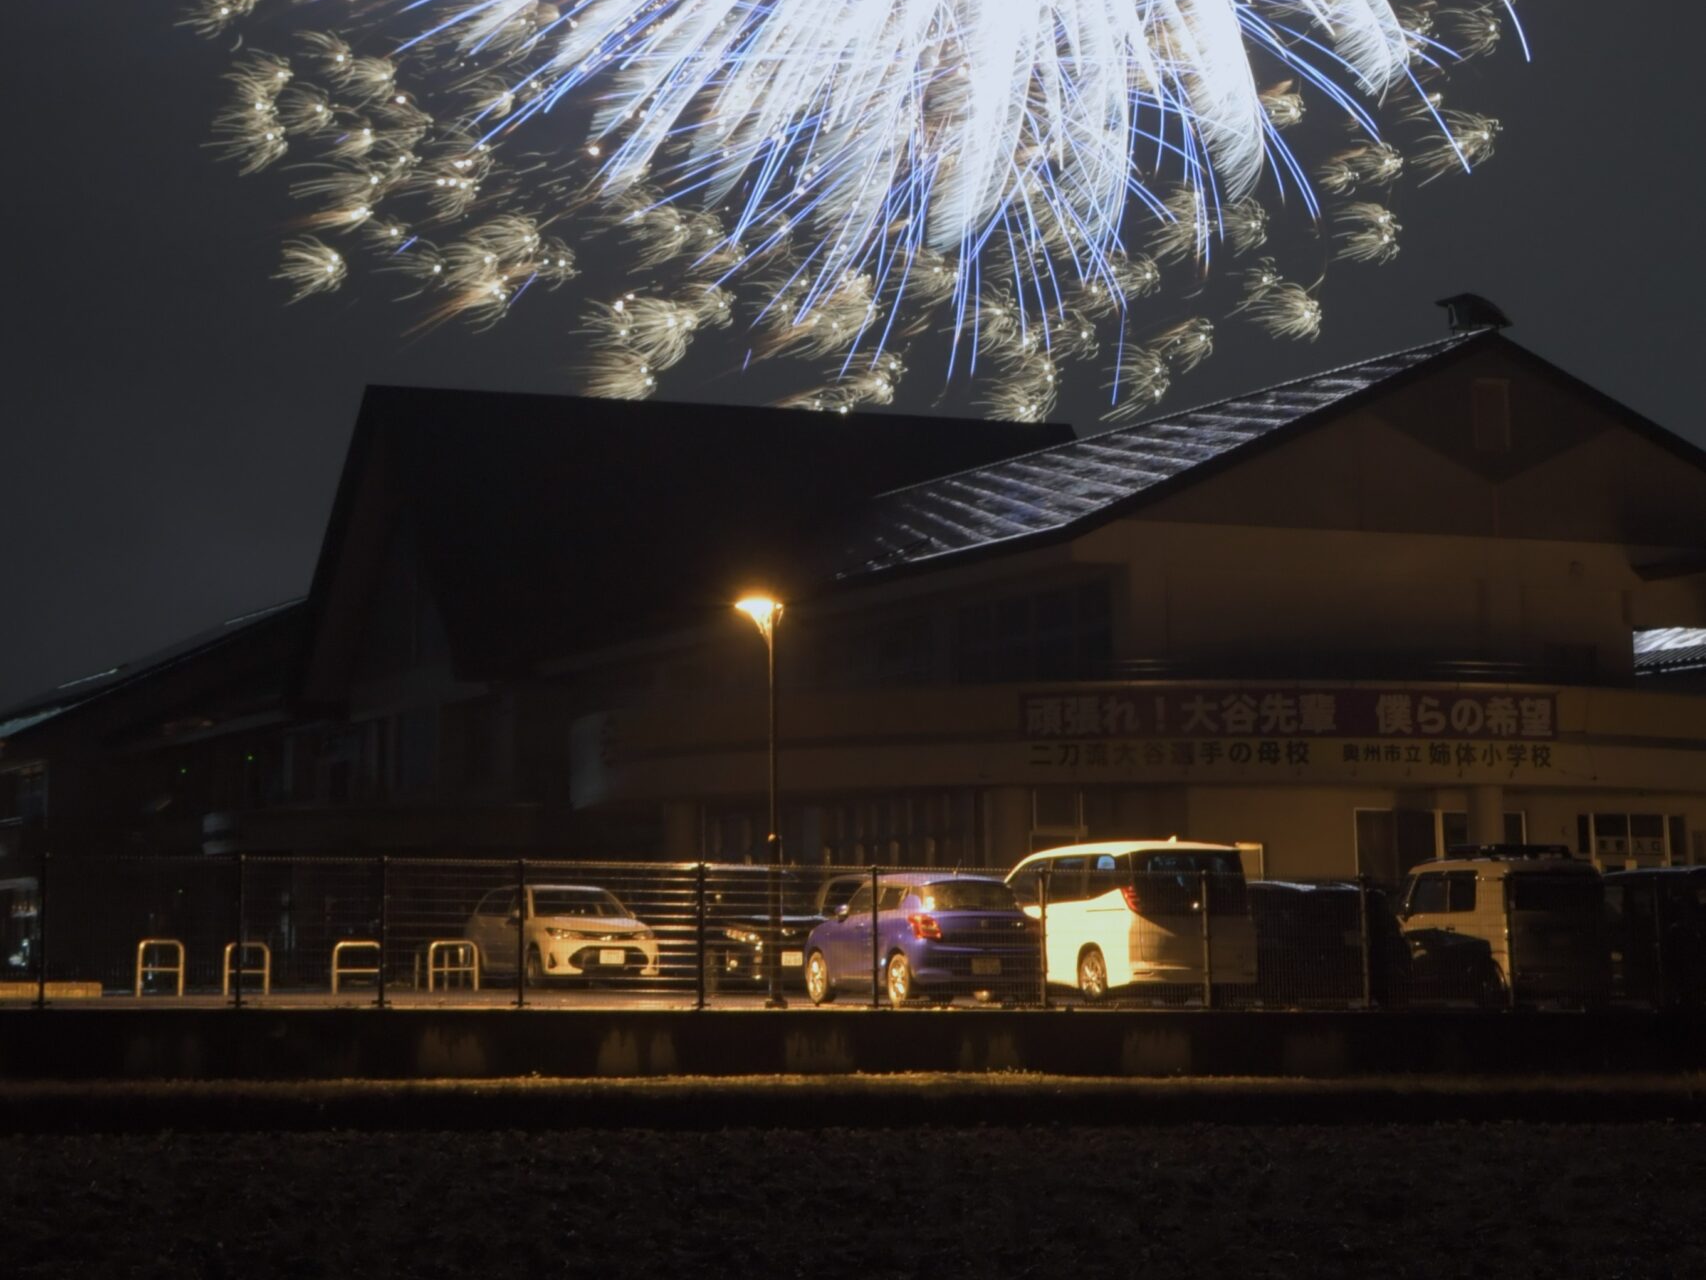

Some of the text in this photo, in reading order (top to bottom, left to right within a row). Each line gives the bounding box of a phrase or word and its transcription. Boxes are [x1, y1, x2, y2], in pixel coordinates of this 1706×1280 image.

[1375, 694, 1554, 737] 僕らの希望
